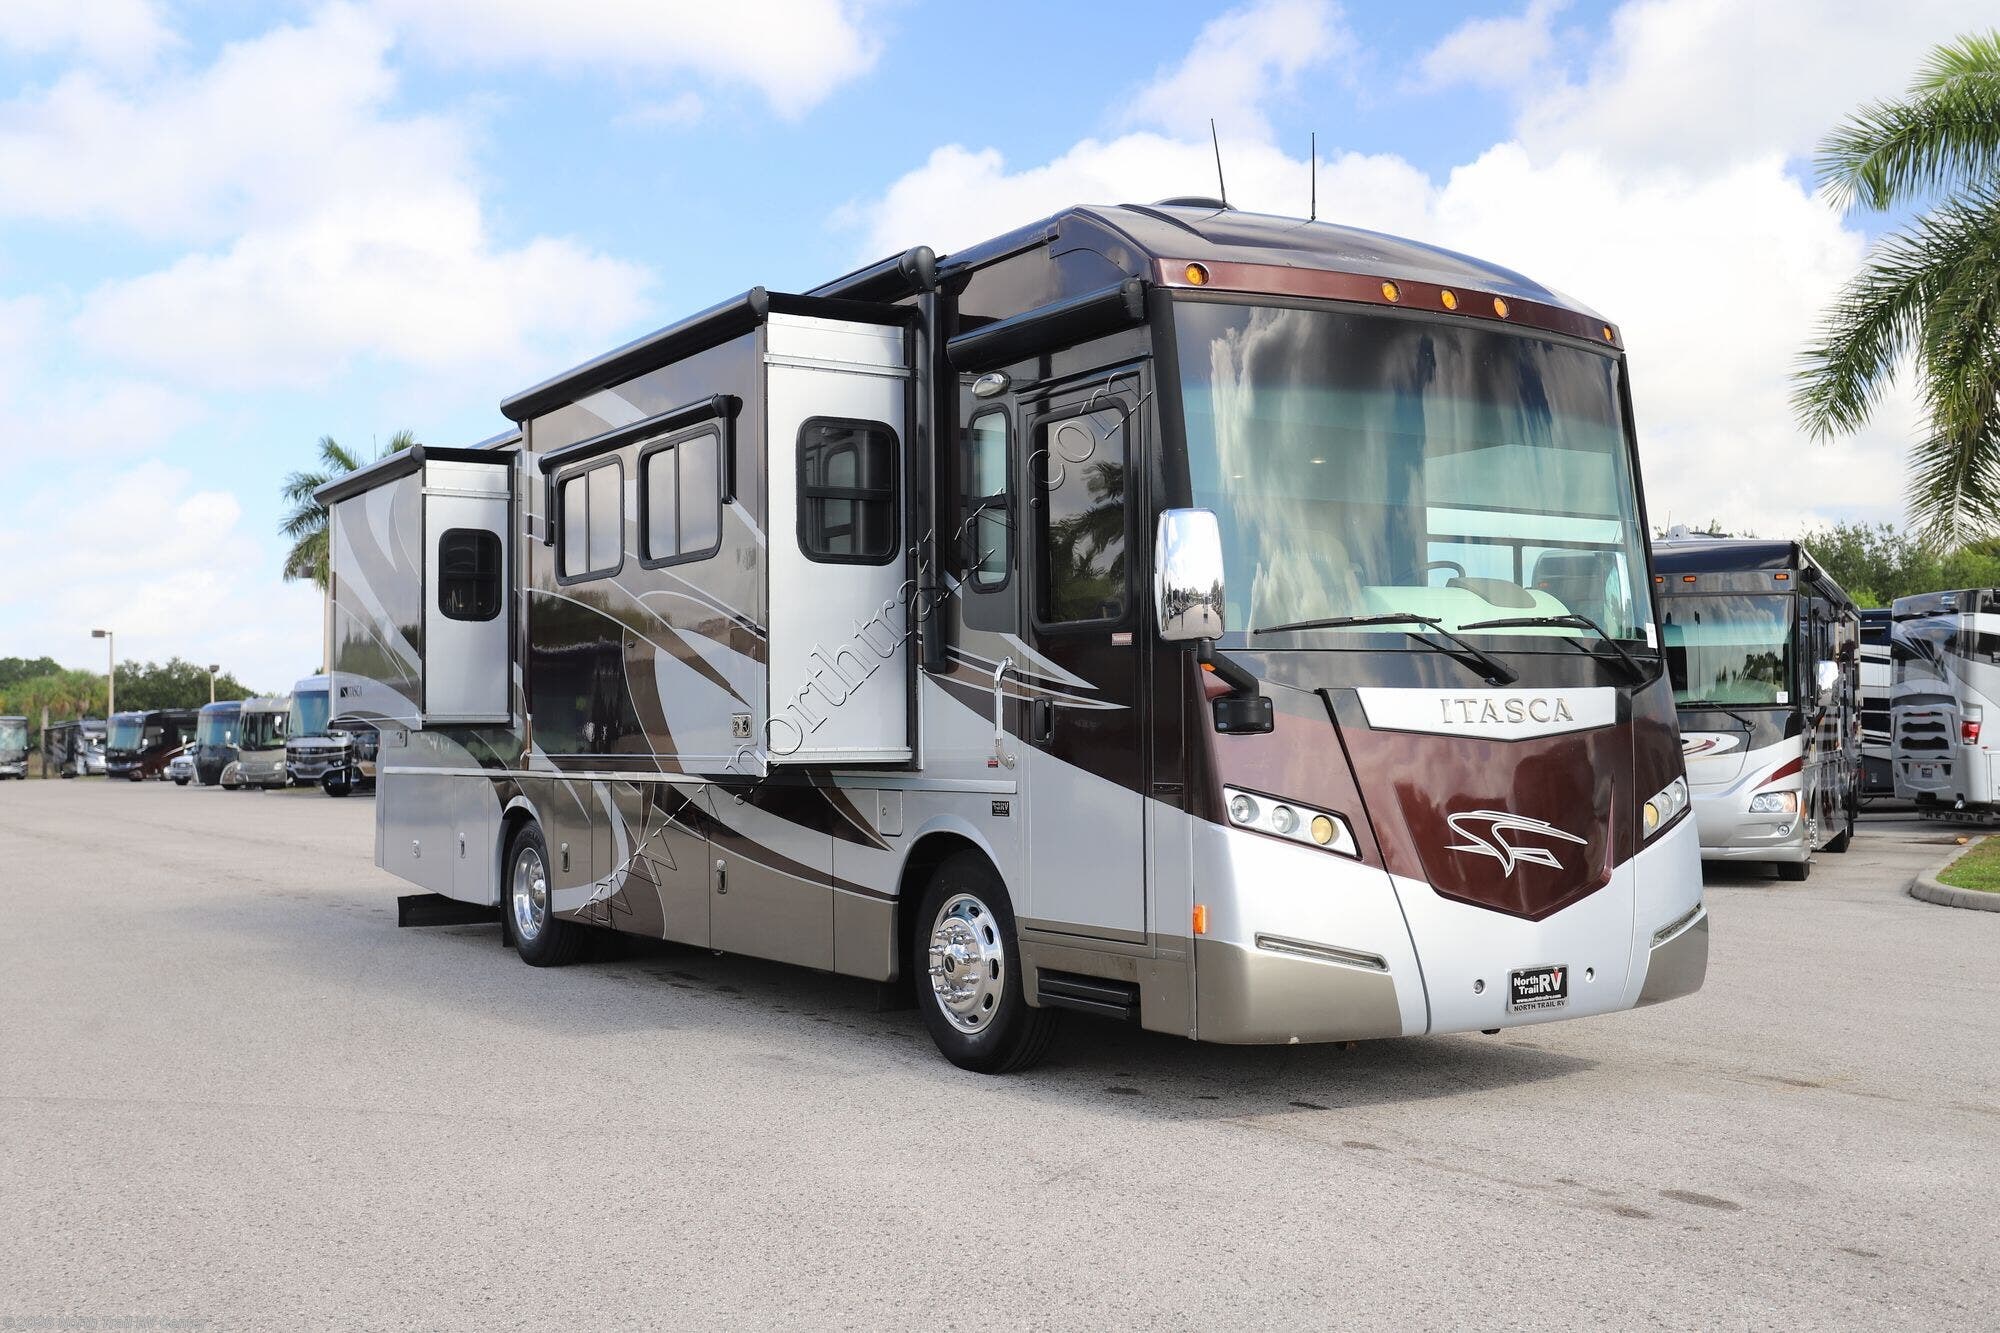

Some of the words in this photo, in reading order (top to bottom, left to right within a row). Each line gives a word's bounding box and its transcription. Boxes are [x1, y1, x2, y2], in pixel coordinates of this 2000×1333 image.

[1440, 697, 1574, 723] ITASCA
[1926, 811, 1985, 823] NEWMAR
[1514, 976, 1538, 986] North
[1539, 972, 1562, 992] RV
[1519, 985, 1538, 995] Trail
[1514, 1004, 1536, 1012] NORTH
[1537, 1001, 1555, 1009] TRAIL
[1557, 999, 1566, 1007] RV
